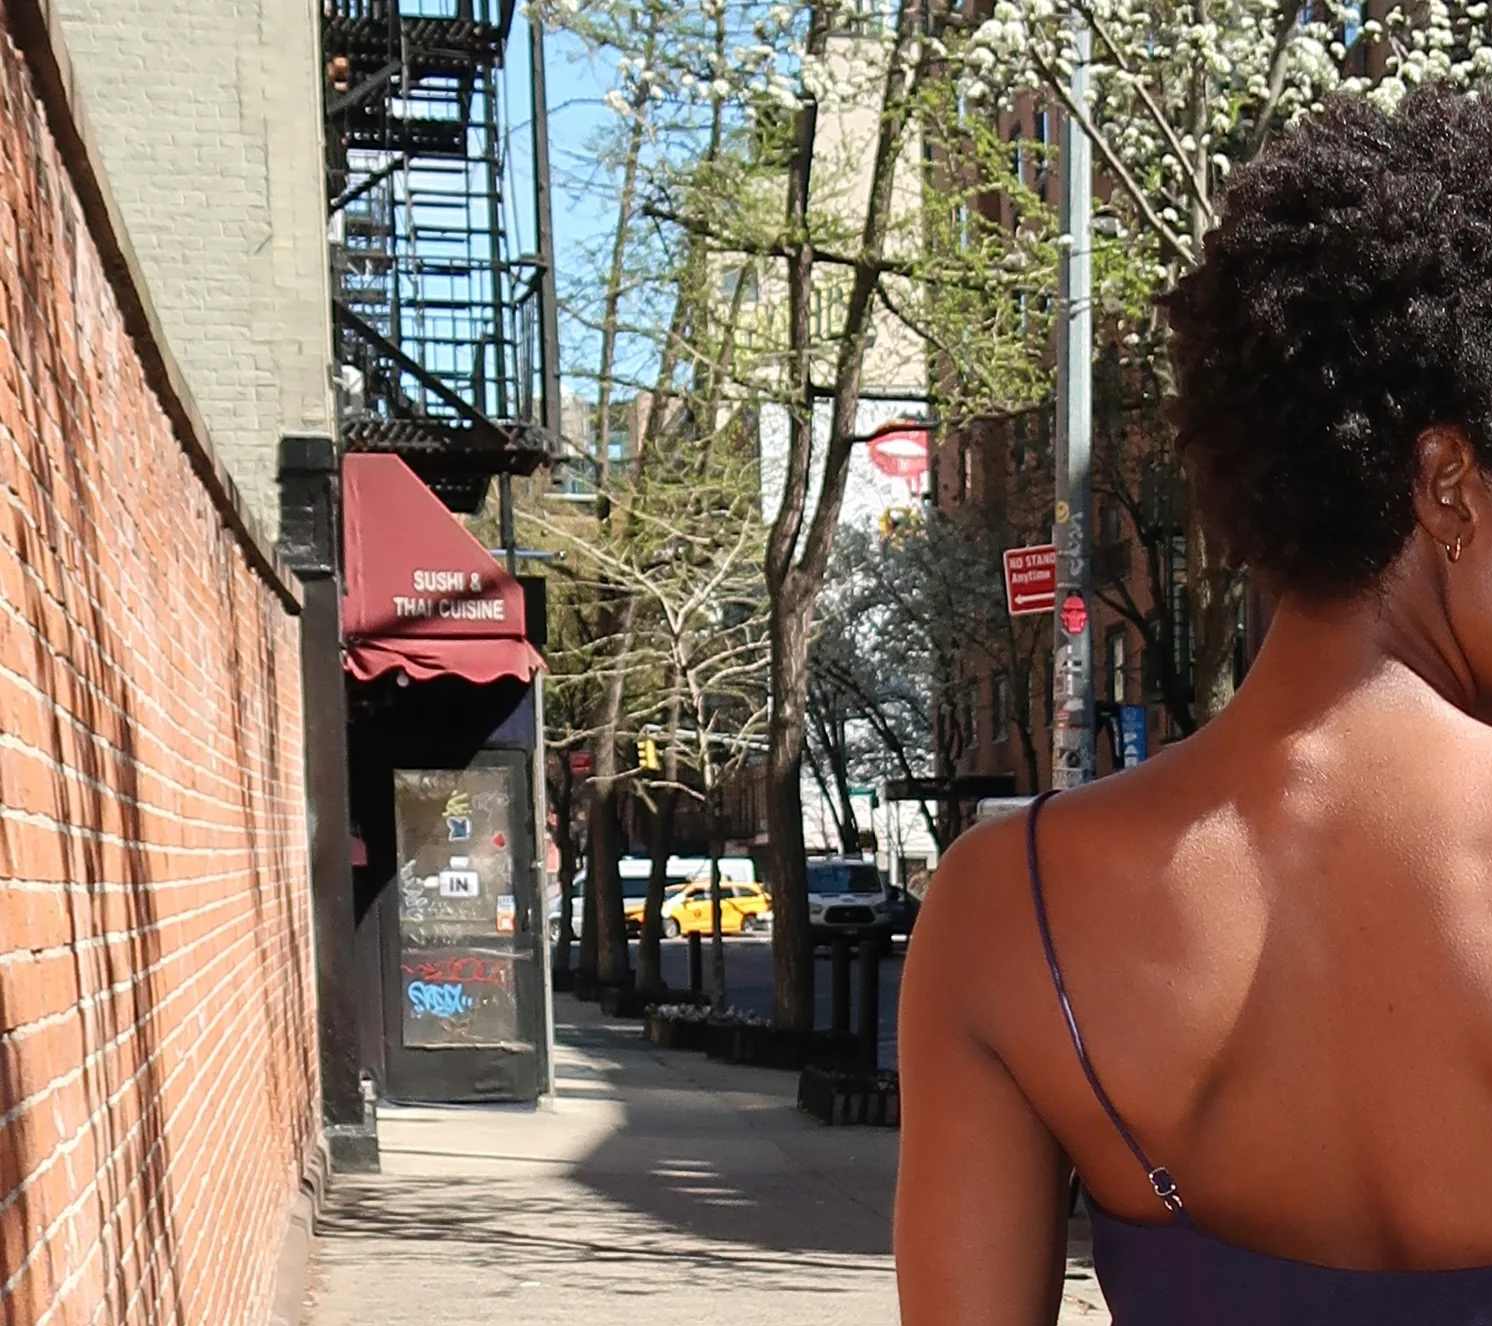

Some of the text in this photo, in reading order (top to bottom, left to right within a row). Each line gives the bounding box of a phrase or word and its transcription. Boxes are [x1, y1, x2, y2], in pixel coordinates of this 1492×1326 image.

[1009, 556, 1023, 569] NO
[413, 569, 482, 592] SUSHI &
[1011, 569, 1051, 586] Anytime
[392, 596, 505, 620] THAI CUISINE
[449, 876, 468, 892] IN
